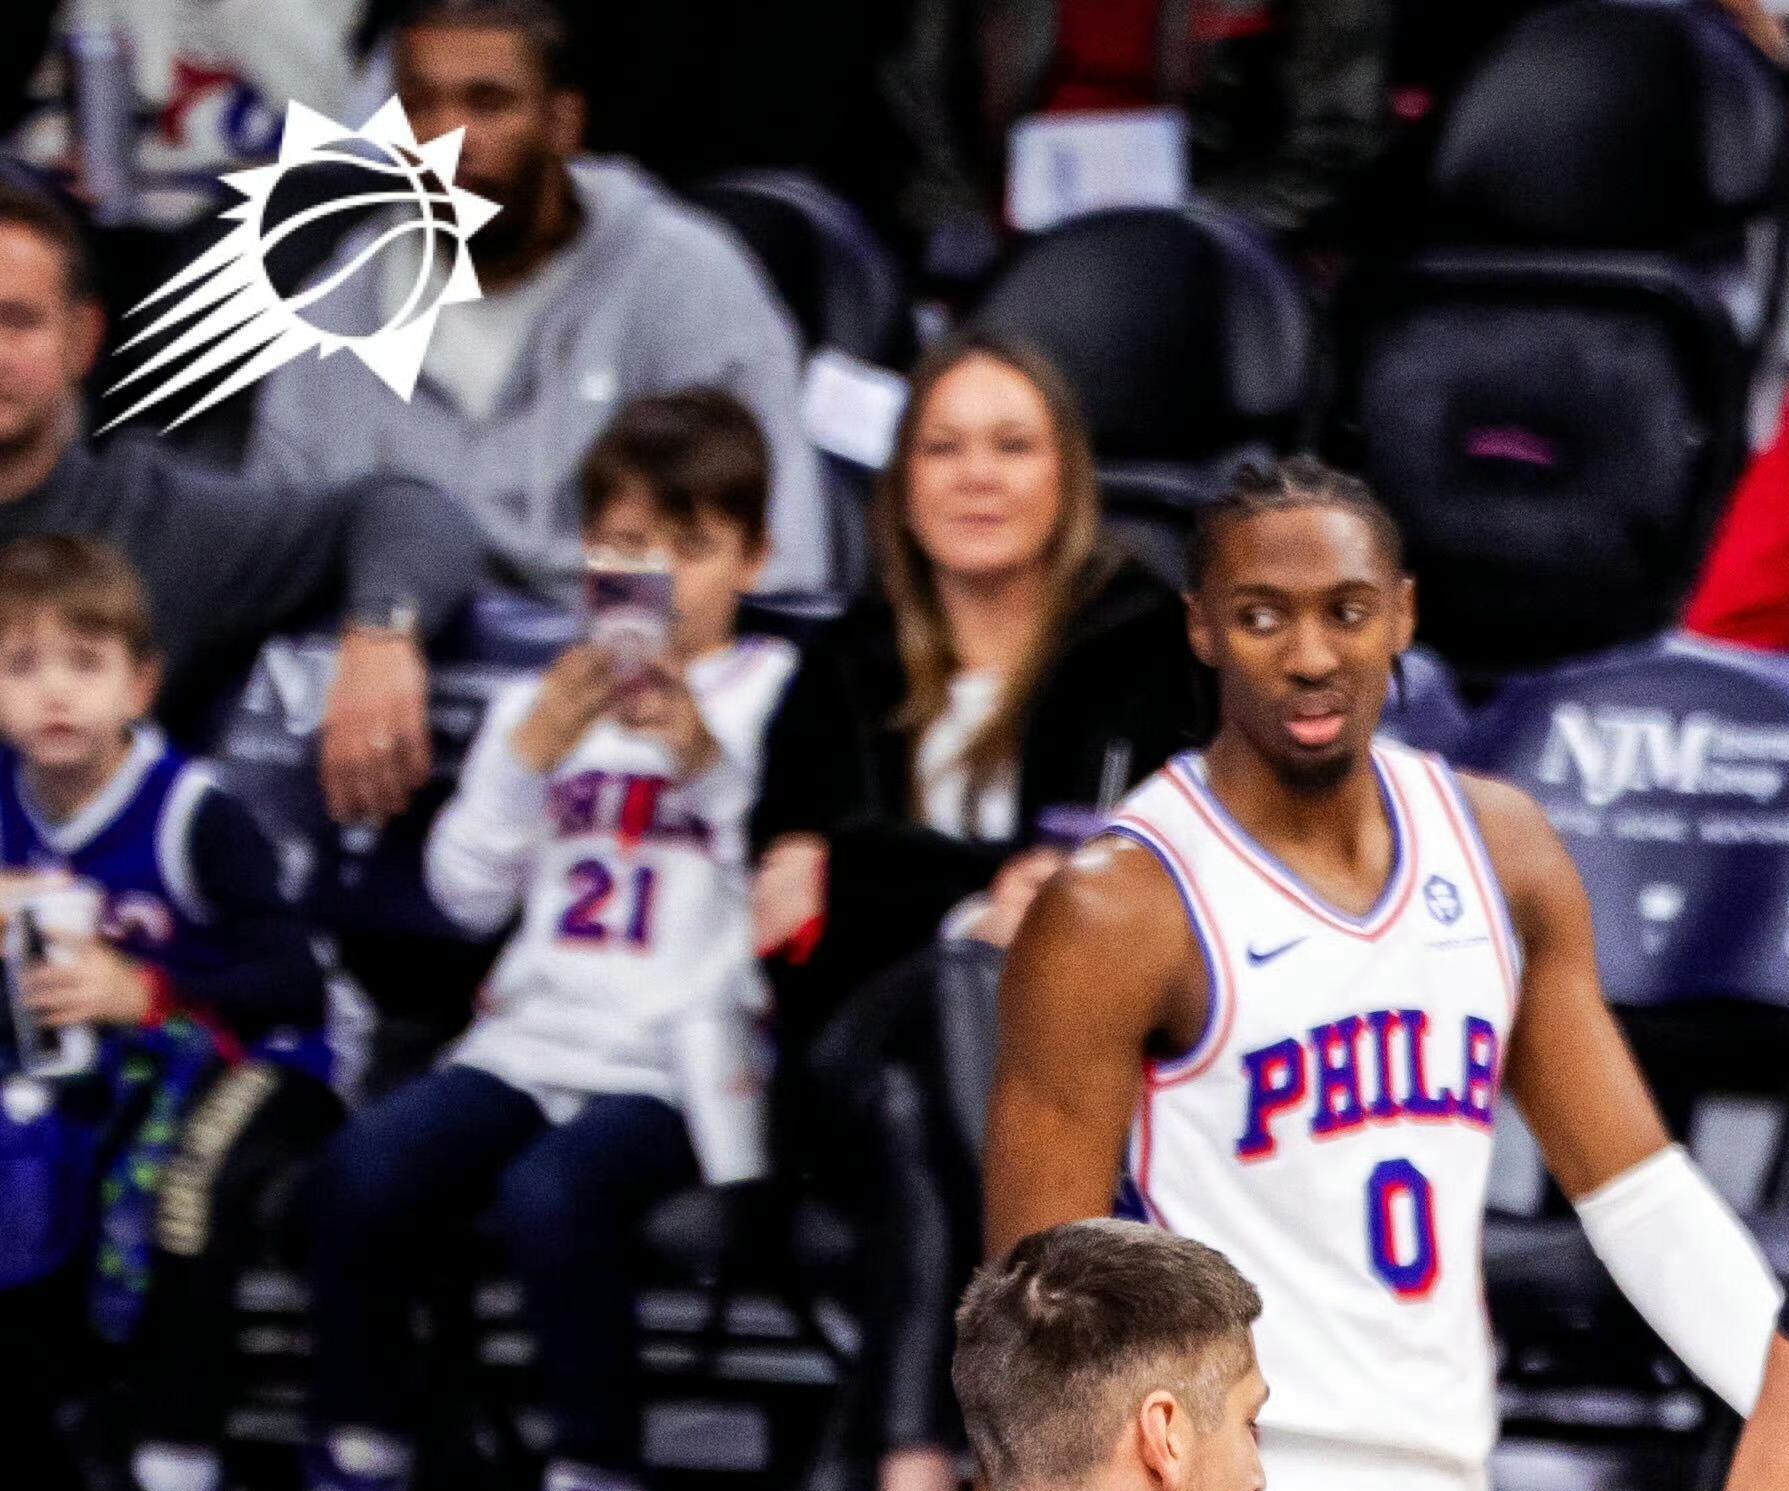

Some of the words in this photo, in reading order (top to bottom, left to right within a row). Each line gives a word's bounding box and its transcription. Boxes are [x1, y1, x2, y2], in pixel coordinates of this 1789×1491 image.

[556, 855, 657, 950] 21
[1236, 1009, 1500, 1164] PHILA
[1366, 1158, 1441, 1303] 0
